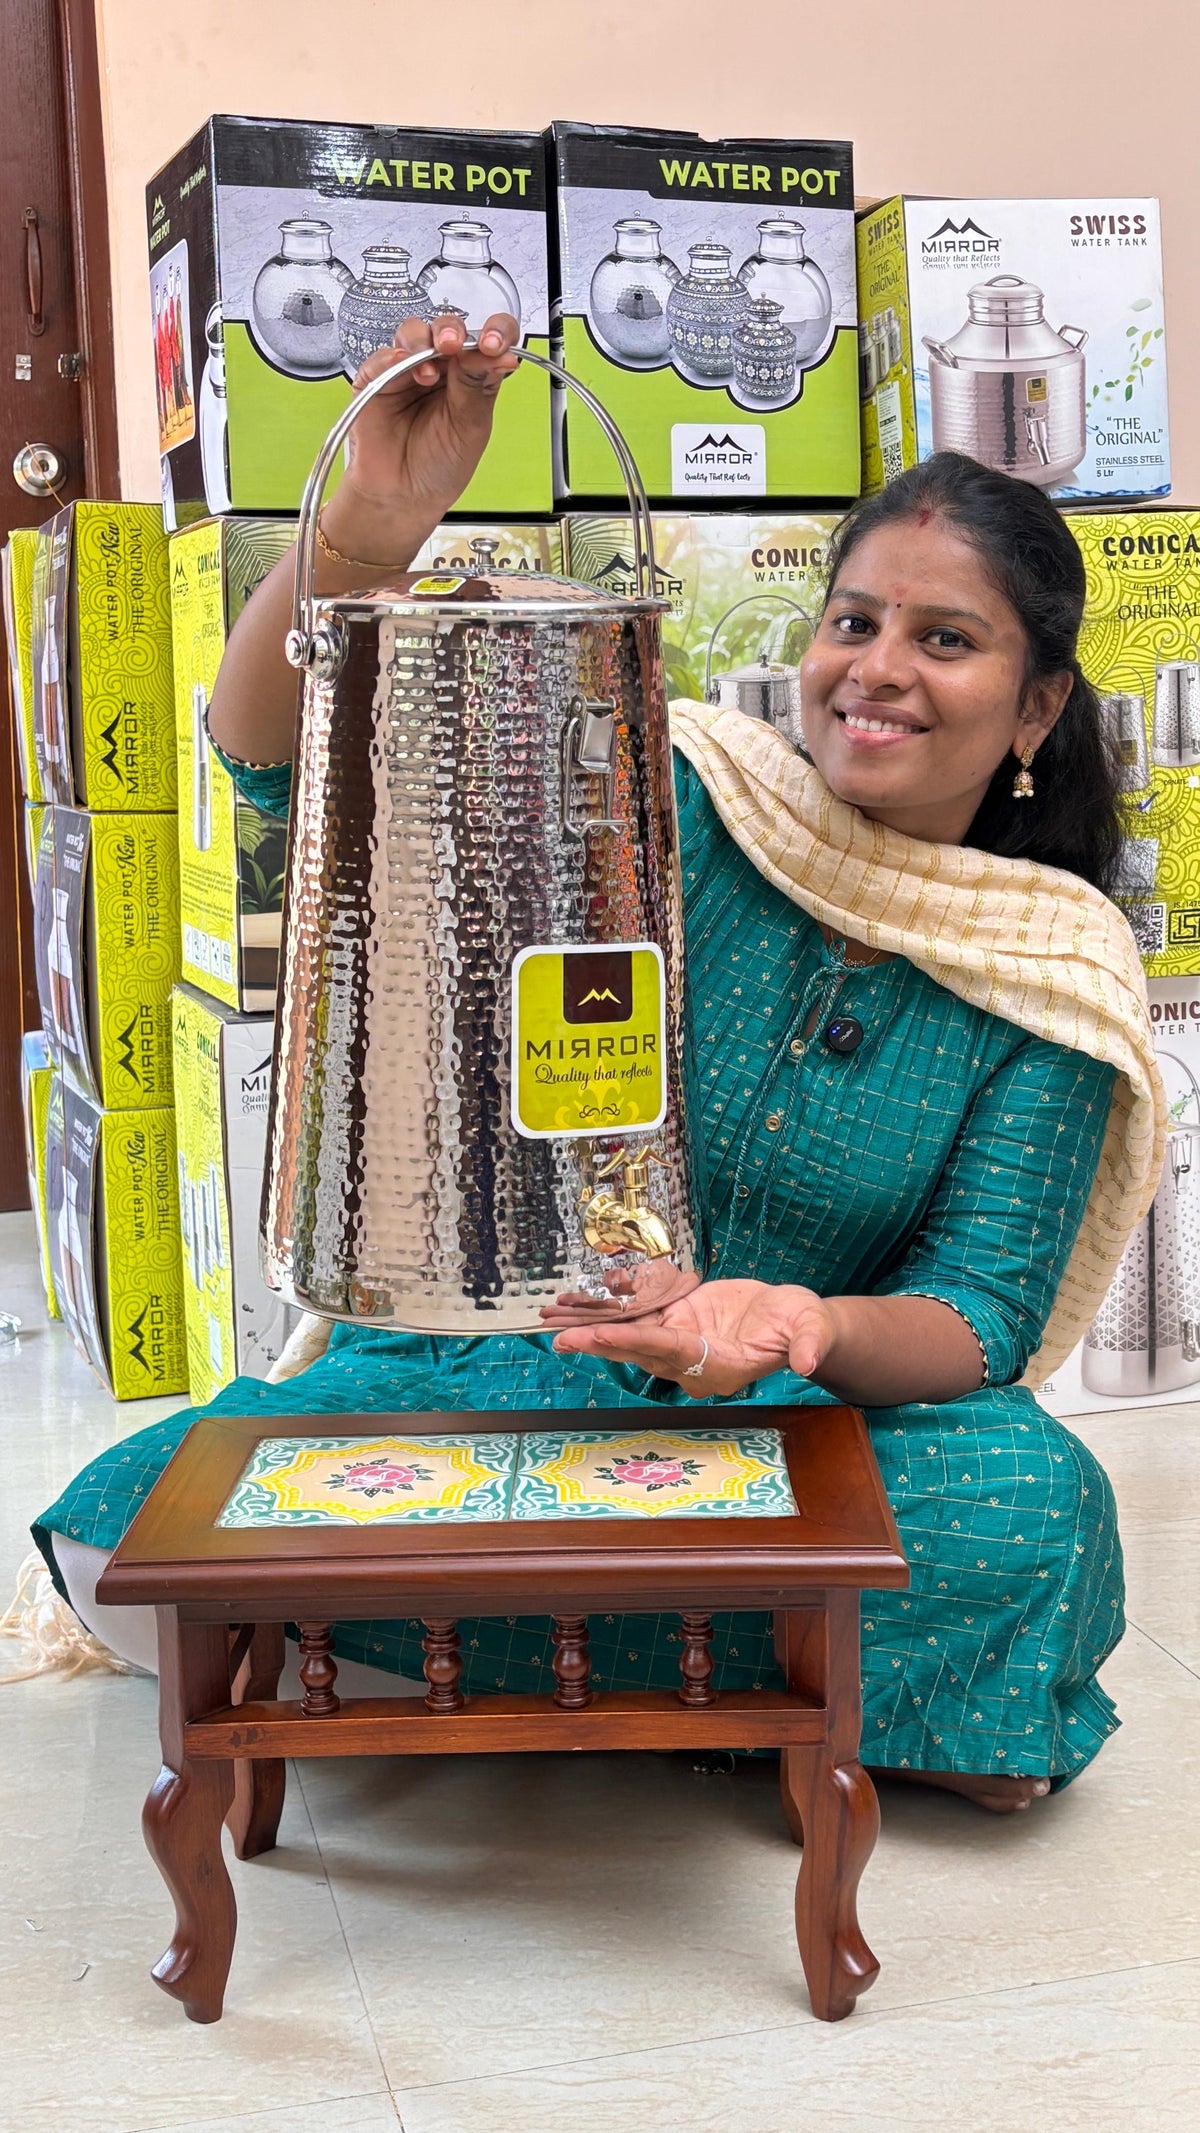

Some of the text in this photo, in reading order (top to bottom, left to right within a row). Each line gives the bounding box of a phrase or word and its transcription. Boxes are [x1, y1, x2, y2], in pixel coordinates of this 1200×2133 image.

[331, 156, 532, 196] WATER POT
[659, 159, 841, 196] WATER POT
[867, 209, 900, 246] SWISS
[1070, 214, 1147, 235] SWISS
[921, 240, 1000, 253] MIRROR
[1071, 238, 1147, 247] WATER TANK
[922, 254, 1001, 265] Quality that Reflects
[684, 452, 752, 465] MIRROR
[1096, 454, 1165, 466] STAINLESS STEEL
[684, 472, 708, 484] Quality
[1096, 469, 1115, 478] 5 Ltr
[1103, 534, 1200, 556] CONICA
[1106, 558, 1163, 571] WATER
[101, 521, 121, 641] WATER POT New
[754, 570, 806, 582] WATER
[124, 701, 140, 794] MIRROR
[116, 834, 137, 948] WATER POT New
[1150, 1001, 1200, 1022] ONIC
[140, 1005, 155, 1093] MIRROR
[526, 1034, 656, 1060] MIRROR
[534, 1062, 653, 1091] Quality that reflects
[242, 1093, 268, 1105] Quali
[127, 1130, 147, 1241] WATER POT New
[150, 1294, 166, 1381] MIRROR
